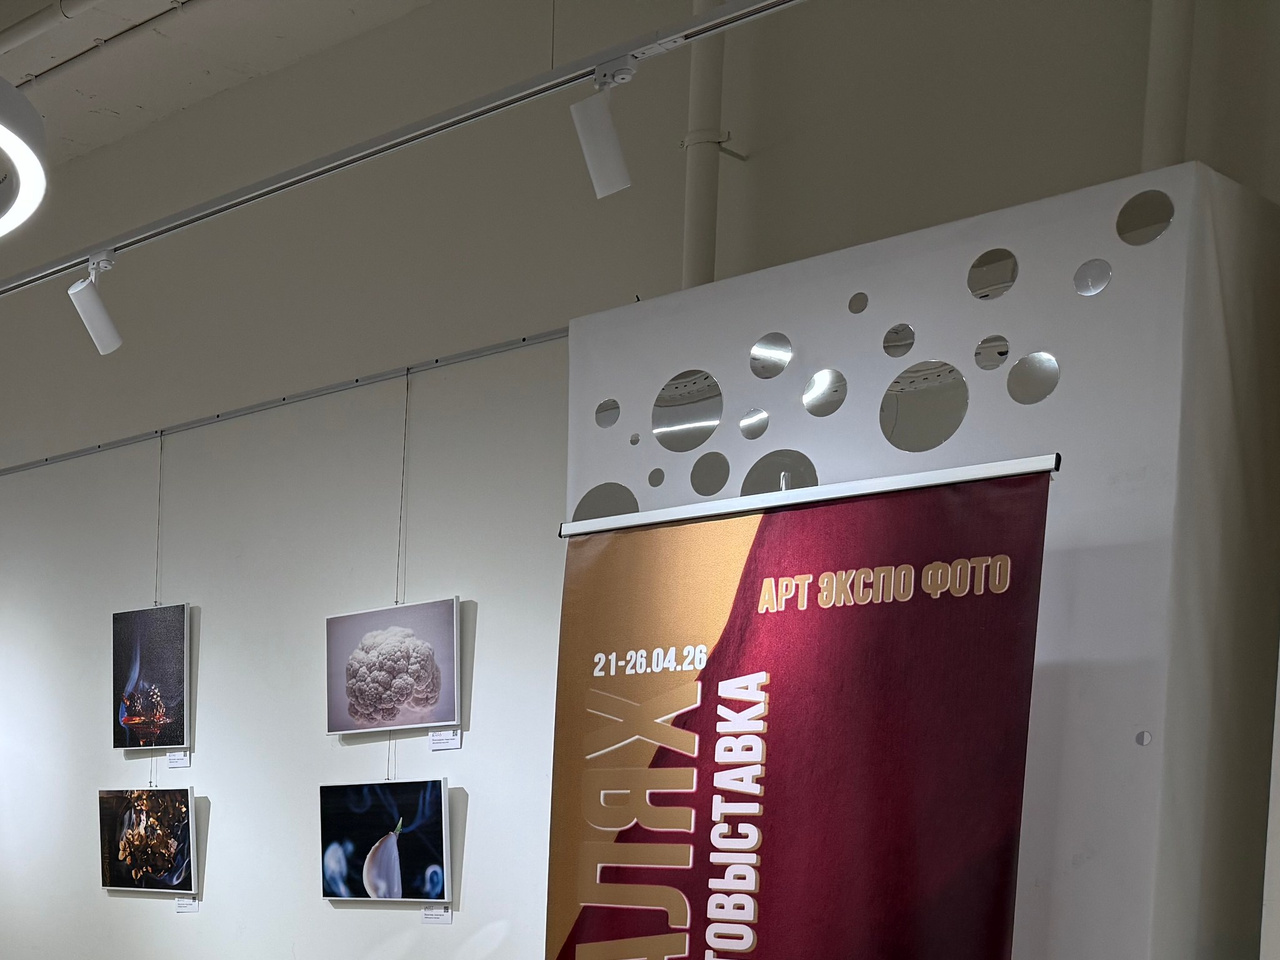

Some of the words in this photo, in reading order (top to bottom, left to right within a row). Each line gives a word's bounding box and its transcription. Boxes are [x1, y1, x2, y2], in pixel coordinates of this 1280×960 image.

[758, 574, 813, 613] АРТ
[818, 564, 915, 609] ЭКСПО
[921, 555, 1012, 599] ФОТО
[593, 644, 707, 677] 21-26.04.26
